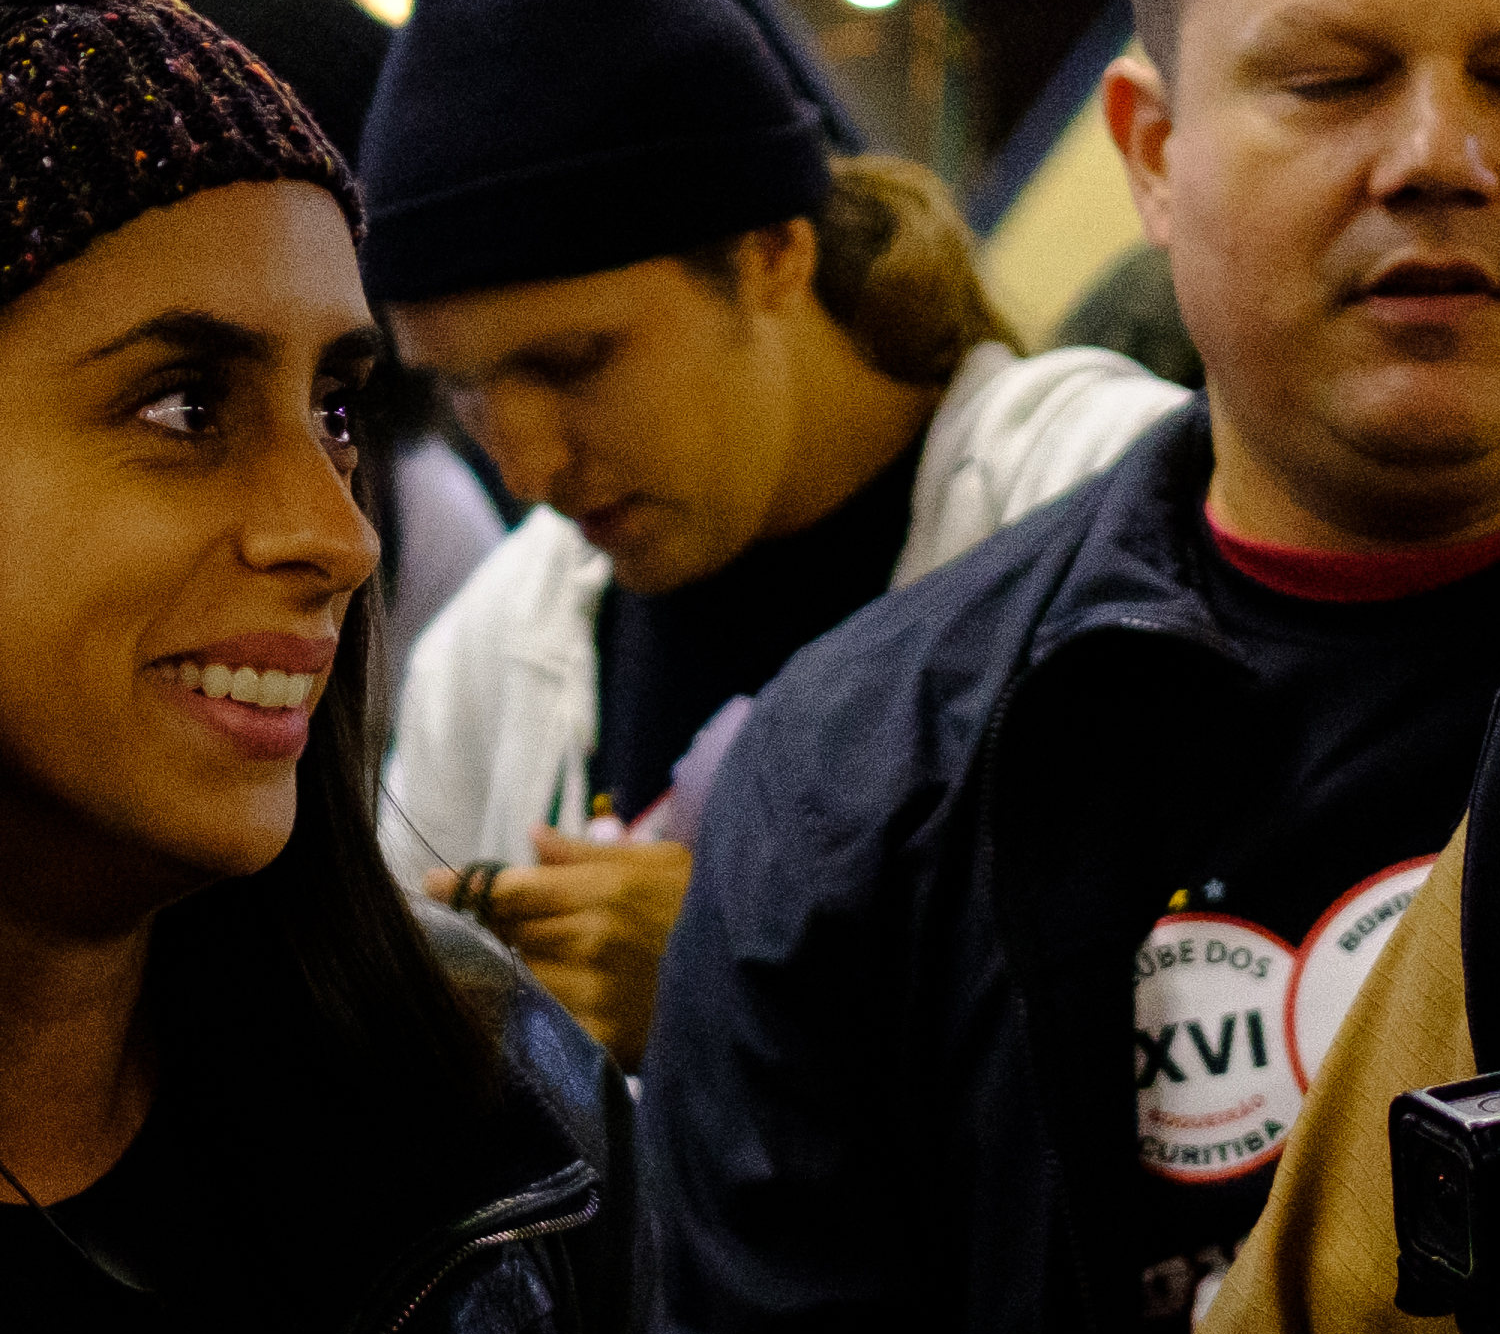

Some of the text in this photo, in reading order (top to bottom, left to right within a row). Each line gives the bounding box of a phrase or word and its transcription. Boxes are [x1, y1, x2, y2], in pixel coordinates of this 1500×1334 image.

[1133, 939, 1272, 983] UBE DOS
[1133, 1010, 1268, 1088] XVI
[1139, 1118, 1284, 1165] CURITIBA
